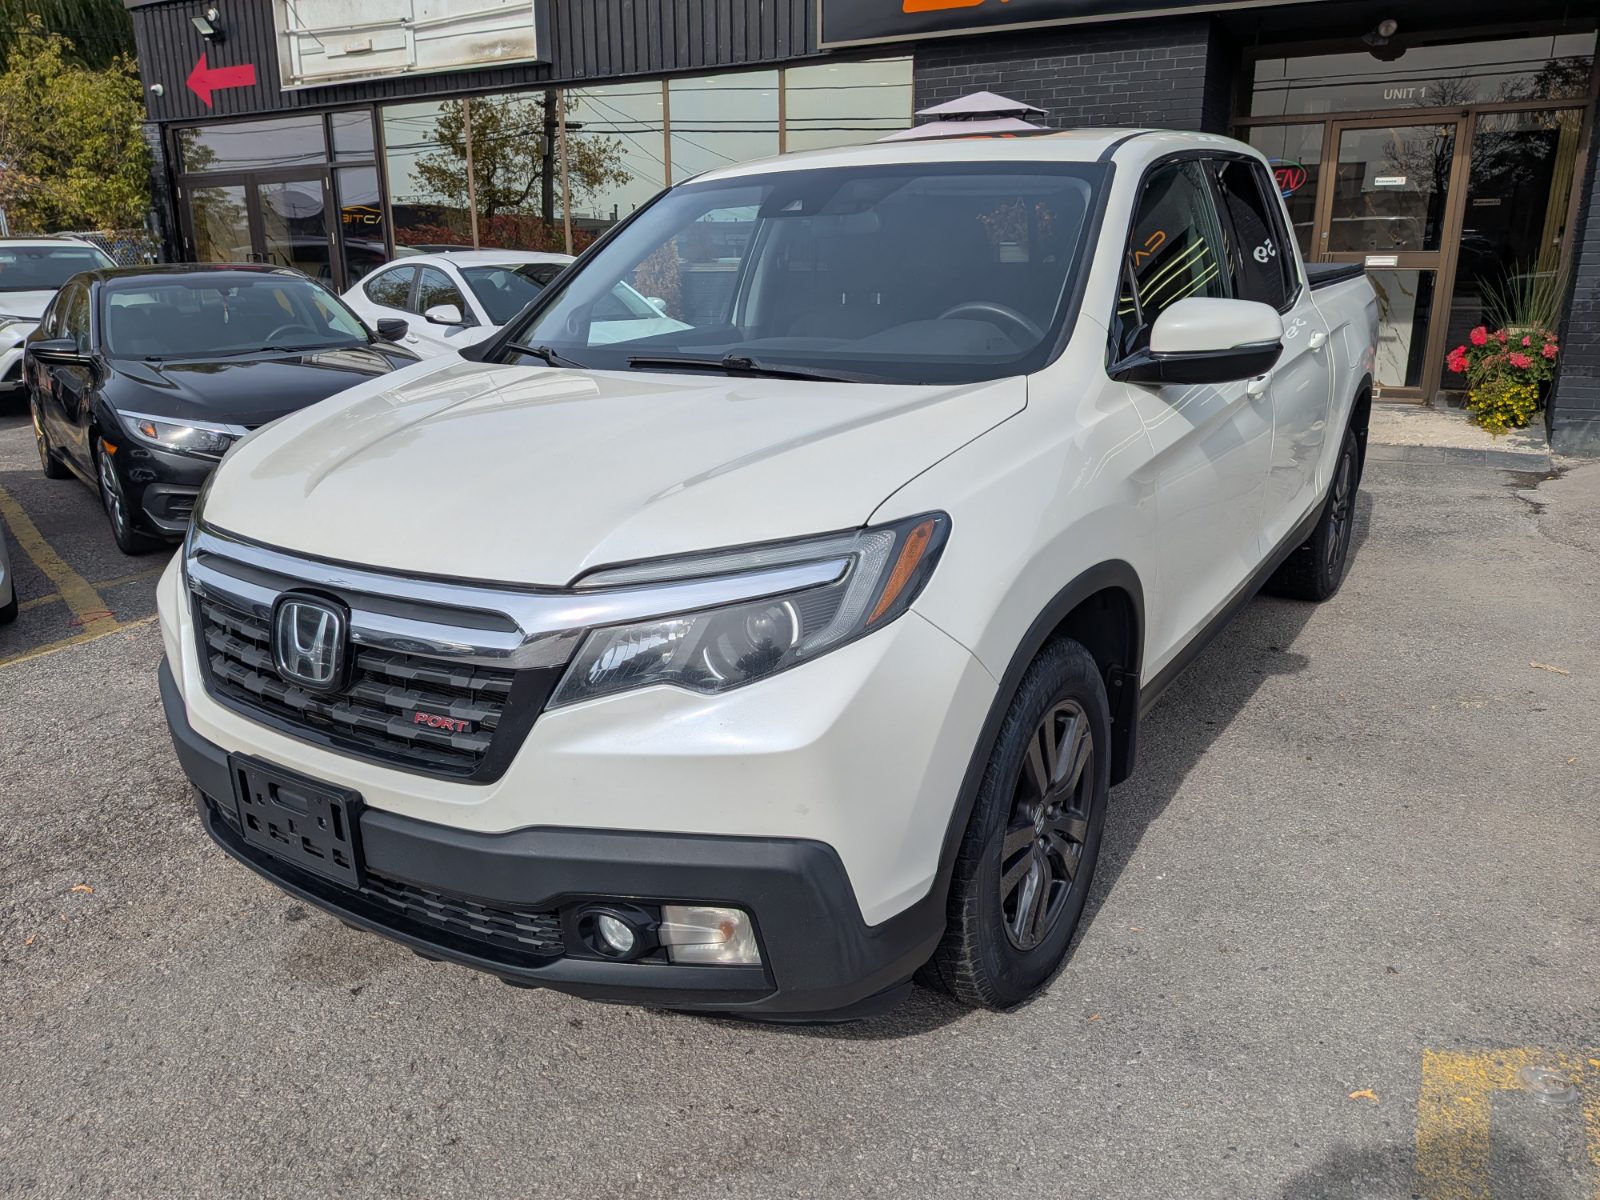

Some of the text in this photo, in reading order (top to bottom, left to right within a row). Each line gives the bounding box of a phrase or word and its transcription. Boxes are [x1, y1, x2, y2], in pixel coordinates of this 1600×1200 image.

[1383, 86, 1426, 100] UNIT 1
[414, 711, 470, 733] PORT
